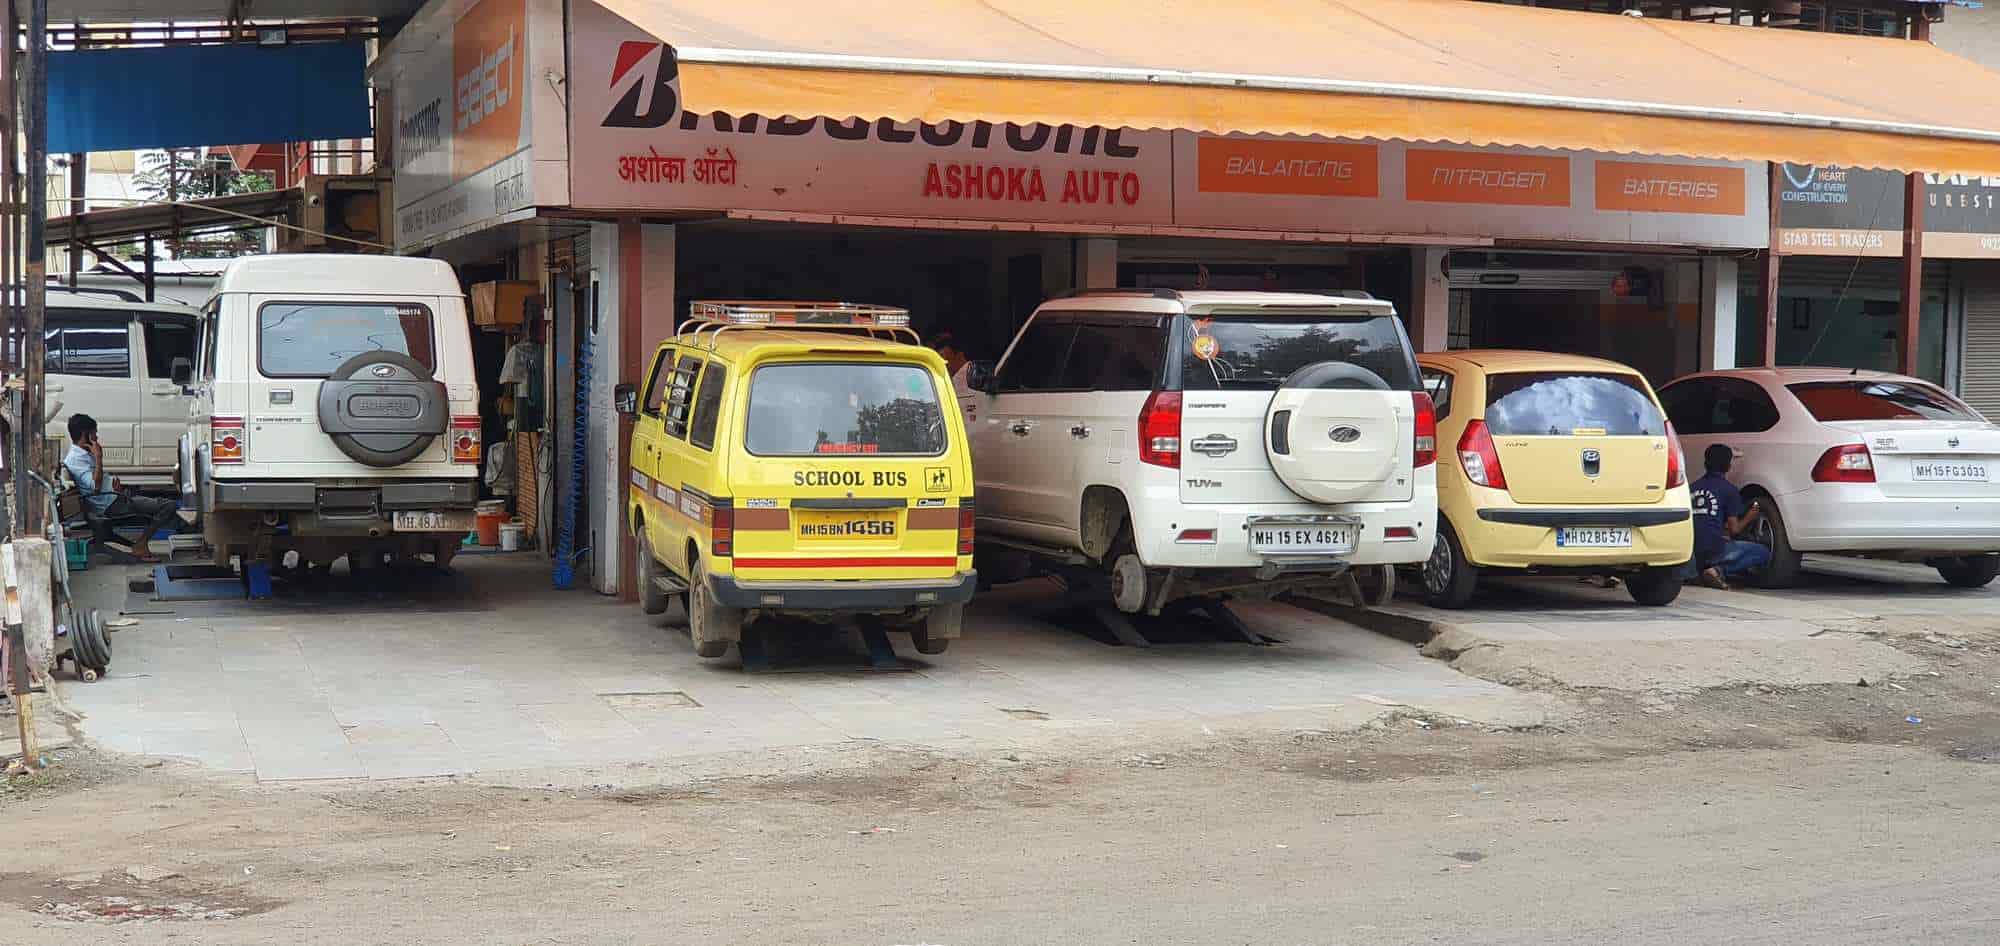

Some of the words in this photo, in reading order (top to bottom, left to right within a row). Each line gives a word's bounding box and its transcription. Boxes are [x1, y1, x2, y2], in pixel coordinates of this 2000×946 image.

[618, 146, 686, 183] अशोका
[693, 148, 737, 185] ऑटो
[1819, 171, 1846, 181] HEART
[923, 163, 1047, 202] ASHOKA
[1060, 169, 1140, 205] AUTO
[1624, 178, 1718, 198] BATTERIES
[1812, 182, 1822, 192] OF
[1824, 182, 1847, 193] EVERY
[1782, 191, 1848, 203] CONSTRUCTION
[1784, 231, 1808, 246] STAR
[1811, 232, 1837, 247] STEEL
[1840, 233, 1883, 248] TRADERS
[794, 471, 865, 486] SCHOOL
[873, 471, 908, 486] BUS
[1255, 531, 1274, 545] MH
[1278, 531, 1291, 544] 15
[1296, 531, 1312, 544] EX
[1316, 530, 1345, 544] 4621
